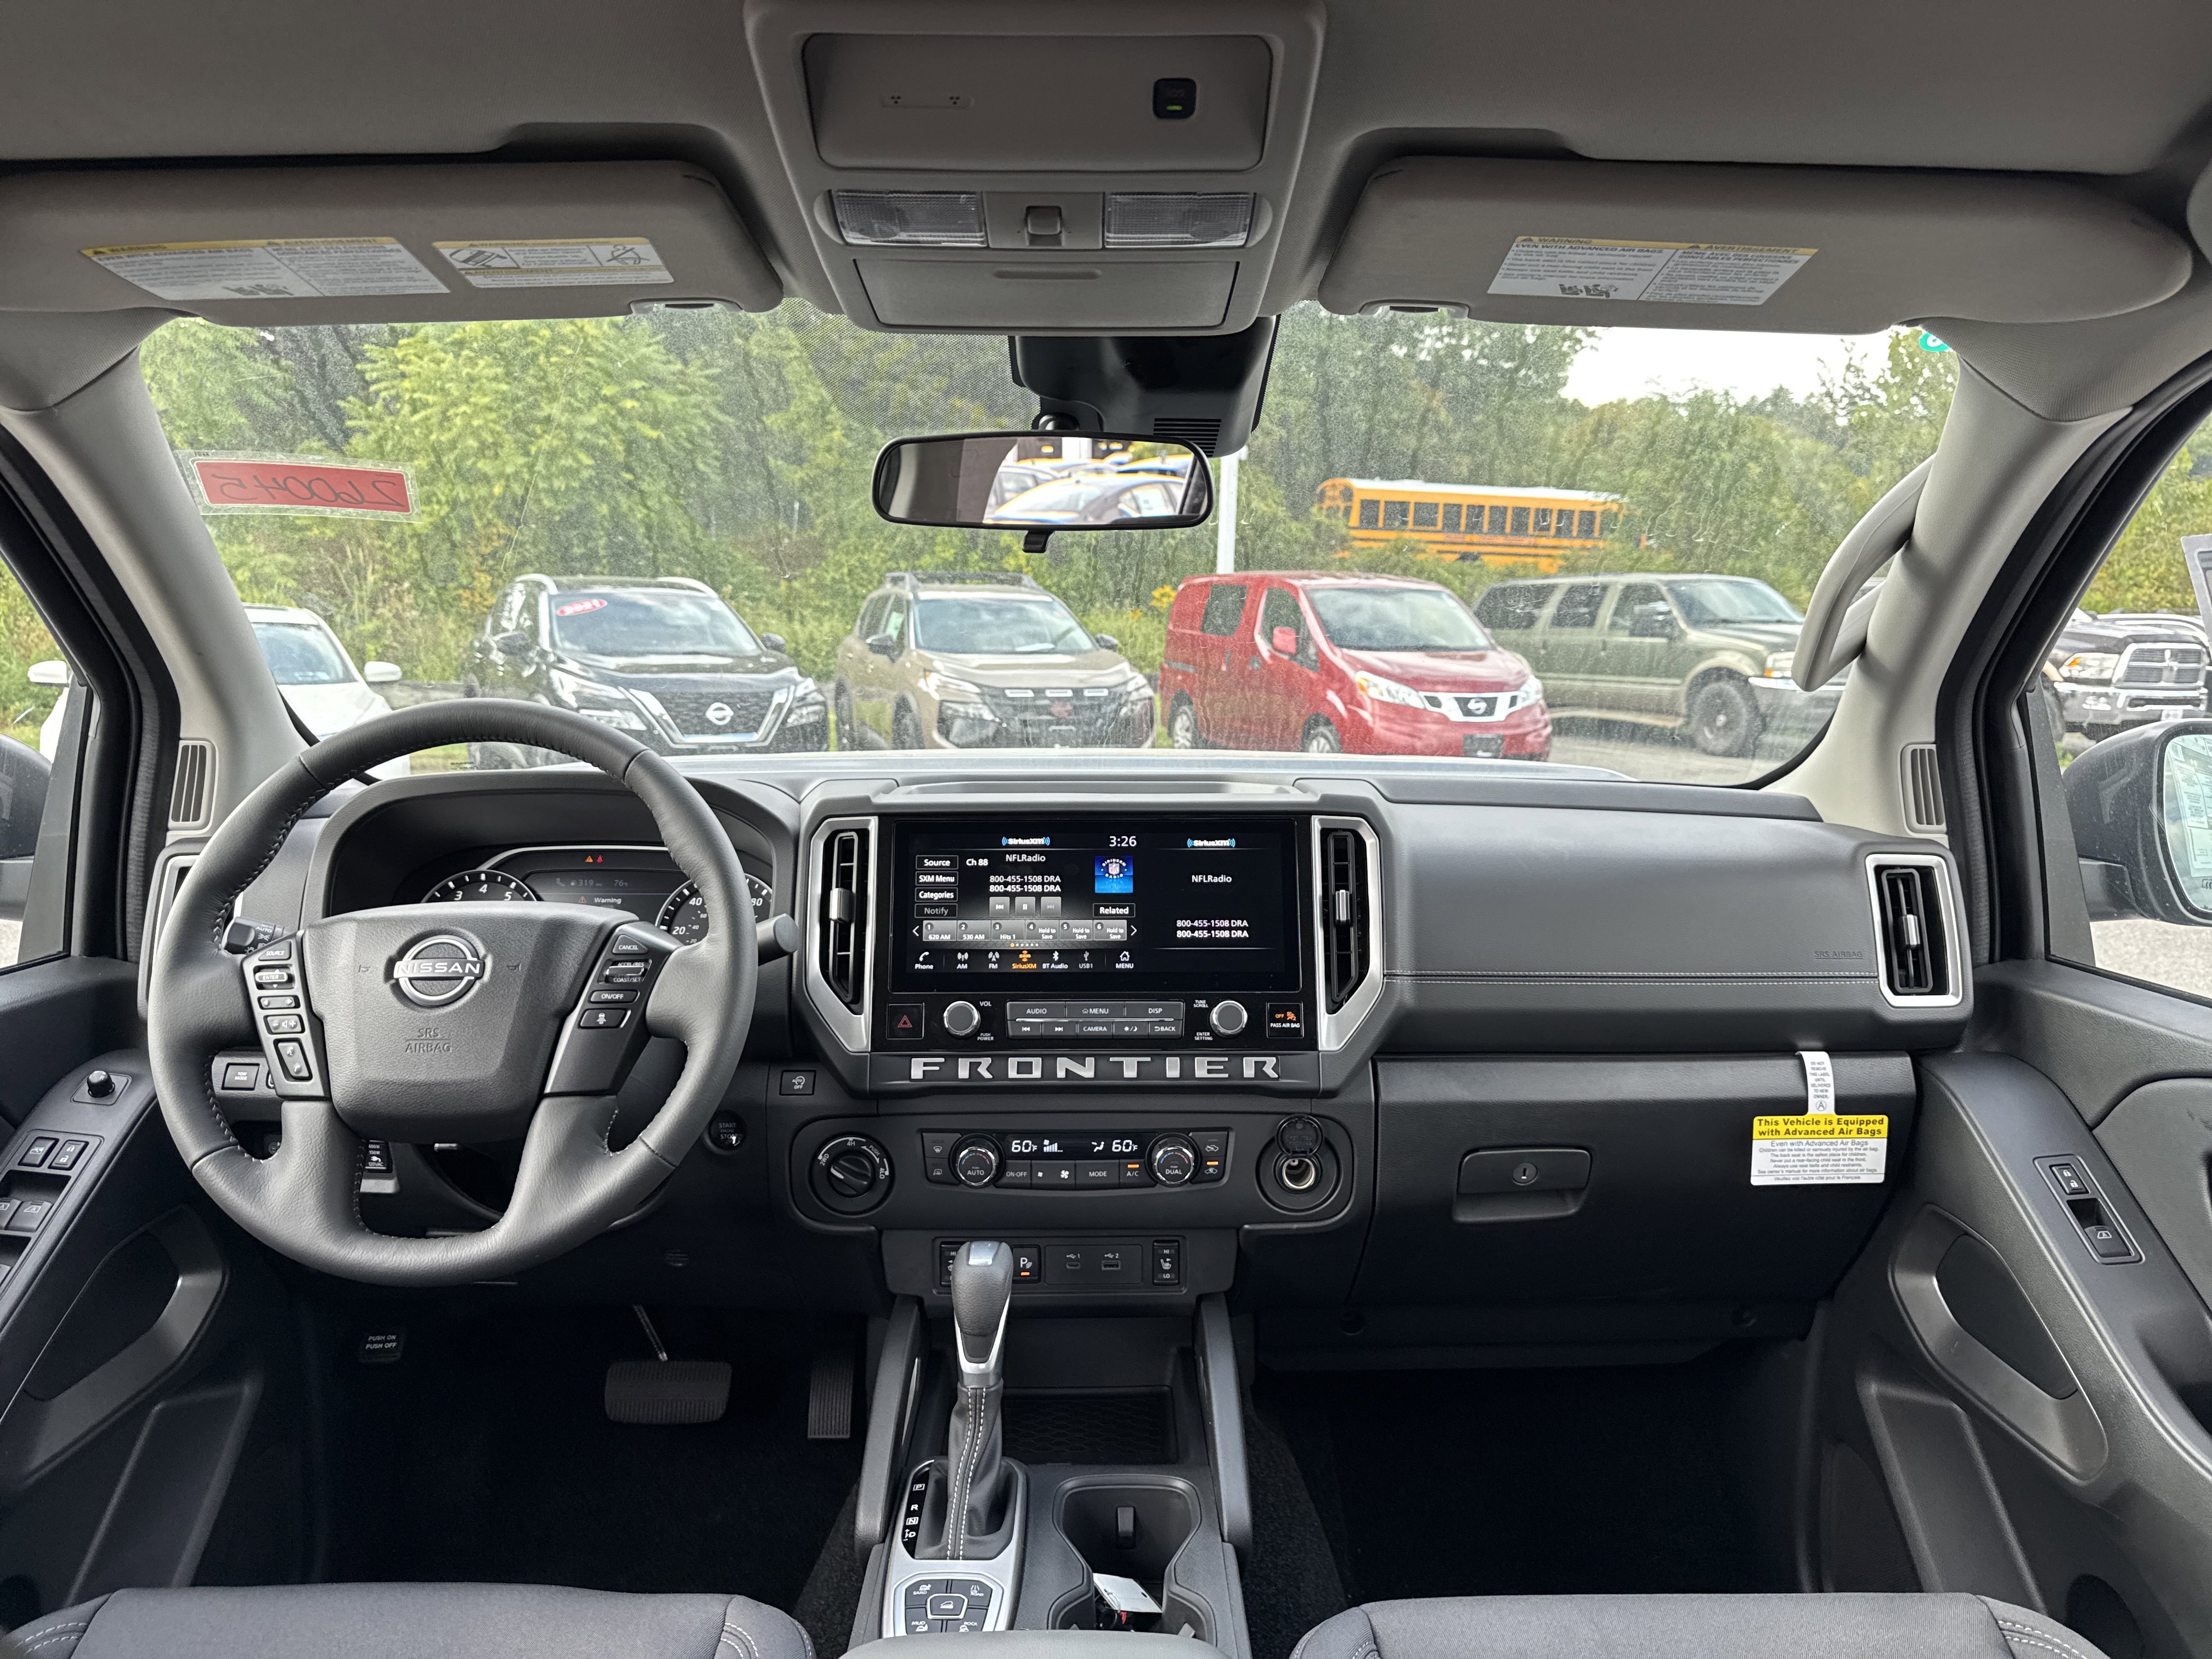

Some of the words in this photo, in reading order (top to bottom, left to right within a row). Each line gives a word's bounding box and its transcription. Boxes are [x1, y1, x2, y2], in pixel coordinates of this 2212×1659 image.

[1109, 836, 1137, 847] 3:26
[1006, 854, 1046, 862] NFLRadio
[1192, 874, 1232, 883] NFLRadio
[479, 884, 488, 894] 4
[454, 890, 463, 901] 3
[504, 891, 512, 901] 5
[594, 896, 622, 905] Warning
[919, 891, 954, 900] Categories
[689, 897, 703, 906] 40
[924, 907, 949, 916] Notify
[1099, 906, 1129, 915] Related
[672, 926, 686, 935] 20
[398, 962, 480, 974] NISSAN
[417, 1028, 439, 1038] SRS
[405, 1042, 453, 1053] AIRBAG
[911, 1057, 1279, 1079] FRONTIER
[1757, 1118, 1779, 1126] This
[1782, 1118, 1821, 1126] Vehicle
[1837, 1117, 1884, 1127] Equipped
[1784, 1127, 1835, 1136] Advanced
[1857, 1127, 1882, 1137] Bags
[1851, 1139, 1868, 1147] Bags
[868, 1144, 881, 1156] PUSH
[819, 1153, 830, 1166] 2WD
